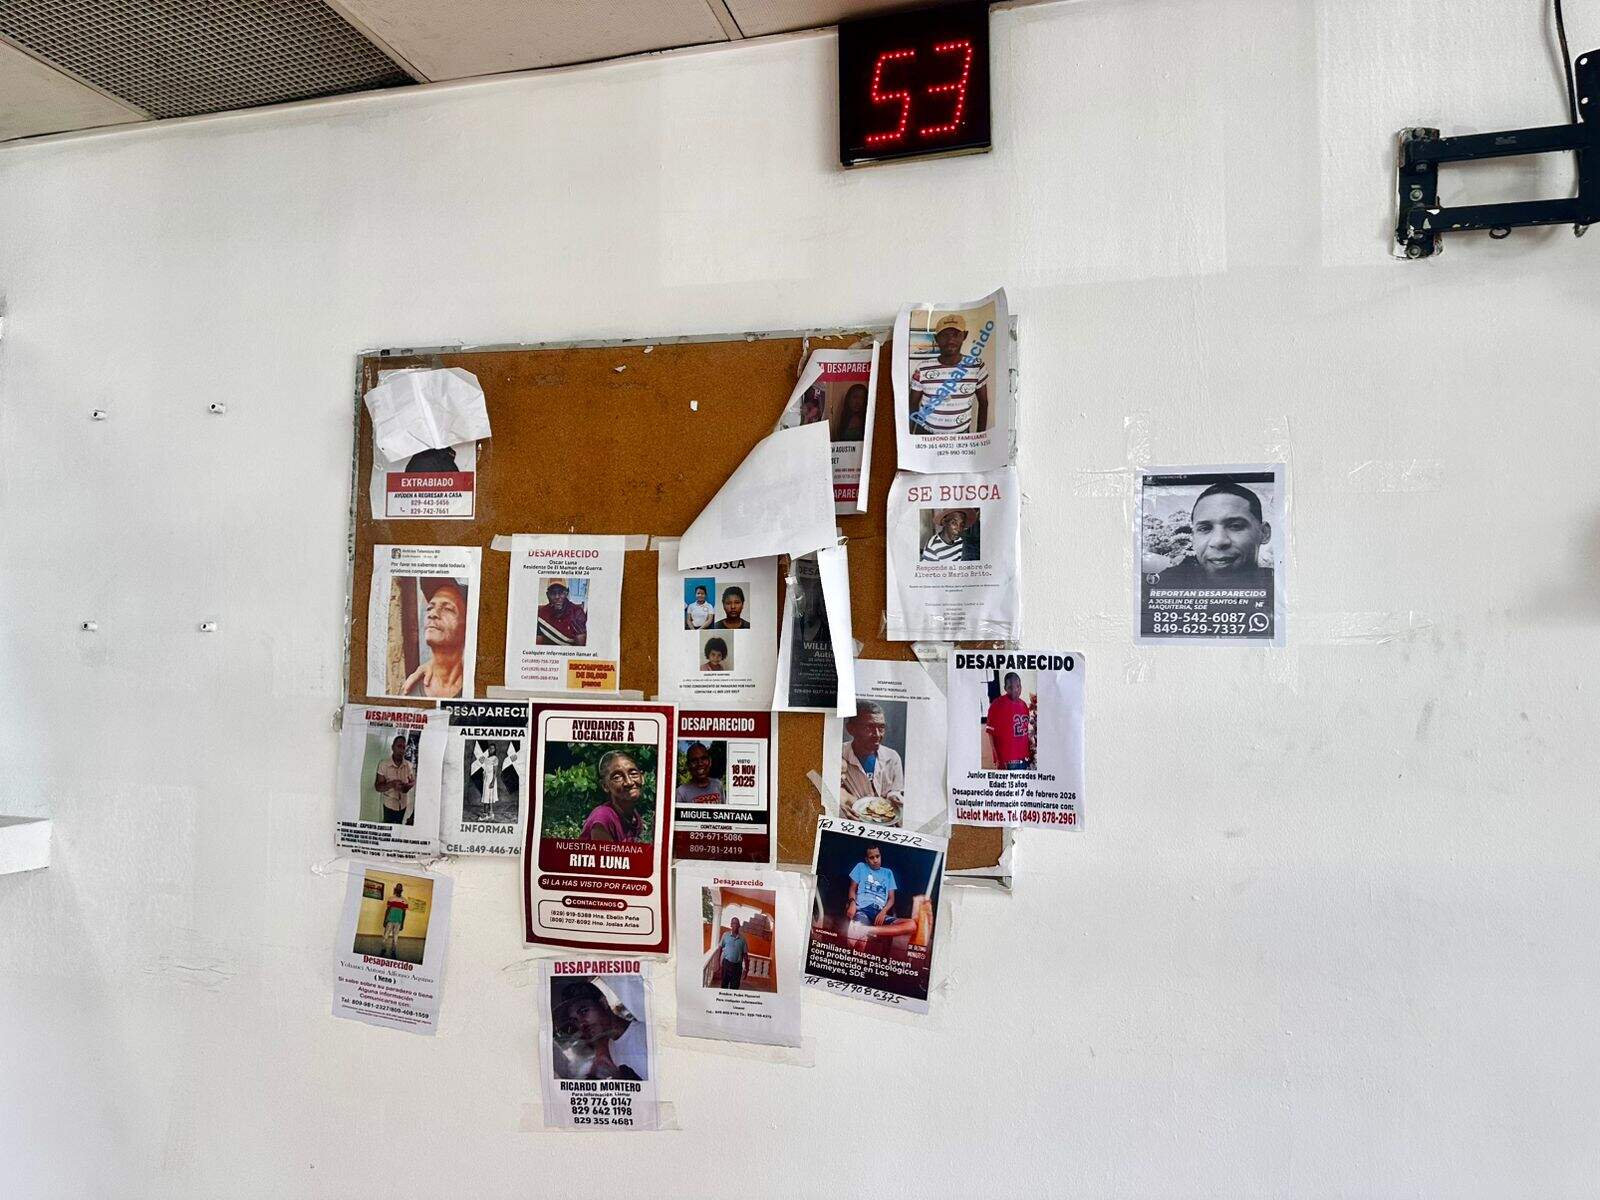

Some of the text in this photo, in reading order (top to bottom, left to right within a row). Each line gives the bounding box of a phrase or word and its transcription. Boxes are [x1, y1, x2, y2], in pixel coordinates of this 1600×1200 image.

[866, 41, 973, 142] 53
[909, 320, 994, 427] Desaparecido
[401, 478, 455, 488] EXTRABIADO
[908, 484, 1002, 502] SE BUSCA
[528, 549, 599, 559] DESAPARECIDO
[916, 564, 948, 572] Responde
[1154, 612, 1246, 623] 829-542-6087
[1153, 624, 1246, 634] 849-629-7337
[569, 663, 615, 672] RECOMPENSA
[956, 654, 1074, 672] DESAPARECIDO
[365, 710, 428, 724] DESAPARECIDA
[572, 720, 635, 731] AYUDANOS A
[681, 717, 755, 731] DESAPARECIDO
[460, 728, 525, 737] ALEXANDRA
[572, 731, 635, 742] LOCALIZAR A
[732, 765, 756, 775] 18 NOV
[967, 771, 987, 780] Junior
[1010, 772, 1036, 780] Mercedes
[733, 776, 755, 788] 2025
[952, 788, 993, 797] Desaparecido
[1020, 789, 1024, 797] 7
[1026, 790, 1034, 798] de
[1035, 790, 1059, 799] febrero
[955, 798, 1074, 810] Cualquier comunicarse con:
[680, 811, 753, 821] MIGUEL SANTANA
[956, 808, 1076, 824] Licelot Marte. Tel. (849) 878-2961
[460, 824, 513, 834] INFORMAR
[690, 832, 743, 842] 829-671-5086
[556, 842, 644, 854] NUESTRA HERMANA
[689, 844, 743, 854] 809-781-2419
[569, 853, 630, 870] RITA LUNA
[622, 884, 647, 892] FAVOR
[713, 878, 764, 887] Desaparecido
[572, 899, 617, 908] CONTACTANOS
[812, 940, 851, 956] Familiares
[853, 948, 880, 962] buscan
[889, 958, 911, 968] joven
[363, 955, 414, 971] Desaparecido
[554, 961, 641, 974] DESAPARESIDO
[810, 953, 862, 971] desaparecido
[875, 968, 889, 977] Los
[811, 948, 919, 977] con problemas psicológicos
[809, 960, 865, 978] Mameyes, SDE
[358, 987, 414, 1002] Alguna información
[386, 986, 412, 995] paradero
[360, 993, 398, 1004] Comunicarse
[560, 1081, 641, 1092] RICARDO MONTERO
[570, 1097, 632, 1107] 829 776 0147
[572, 1106, 632, 1116] 829 642 1198
[594, 1117, 609, 1125] 355
[612, 1118, 634, 1126] 4681
